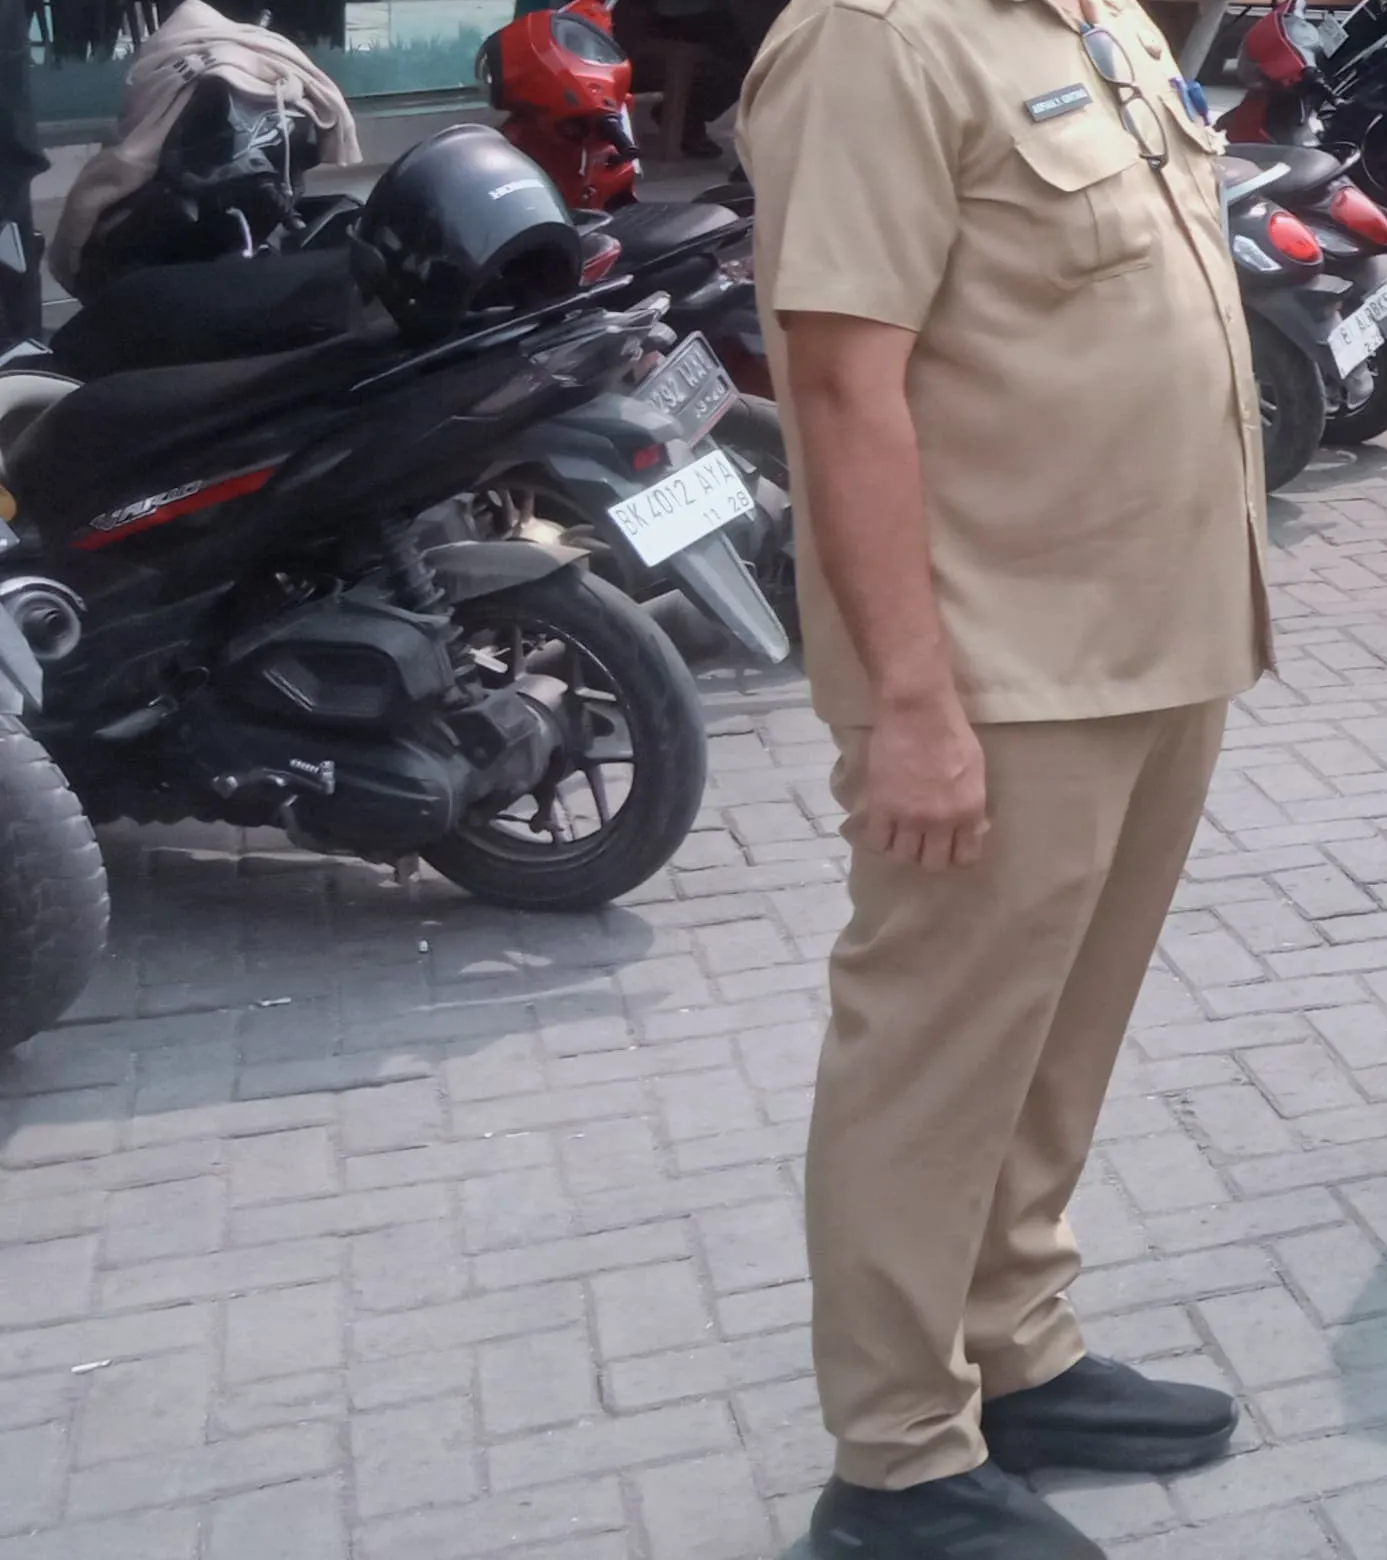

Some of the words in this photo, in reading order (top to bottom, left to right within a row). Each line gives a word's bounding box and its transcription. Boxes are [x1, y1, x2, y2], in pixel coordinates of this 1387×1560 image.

[615, 500, 650, 537] BK
[647, 478, 695, 519] 4012
[695, 456, 735, 495] AYA
